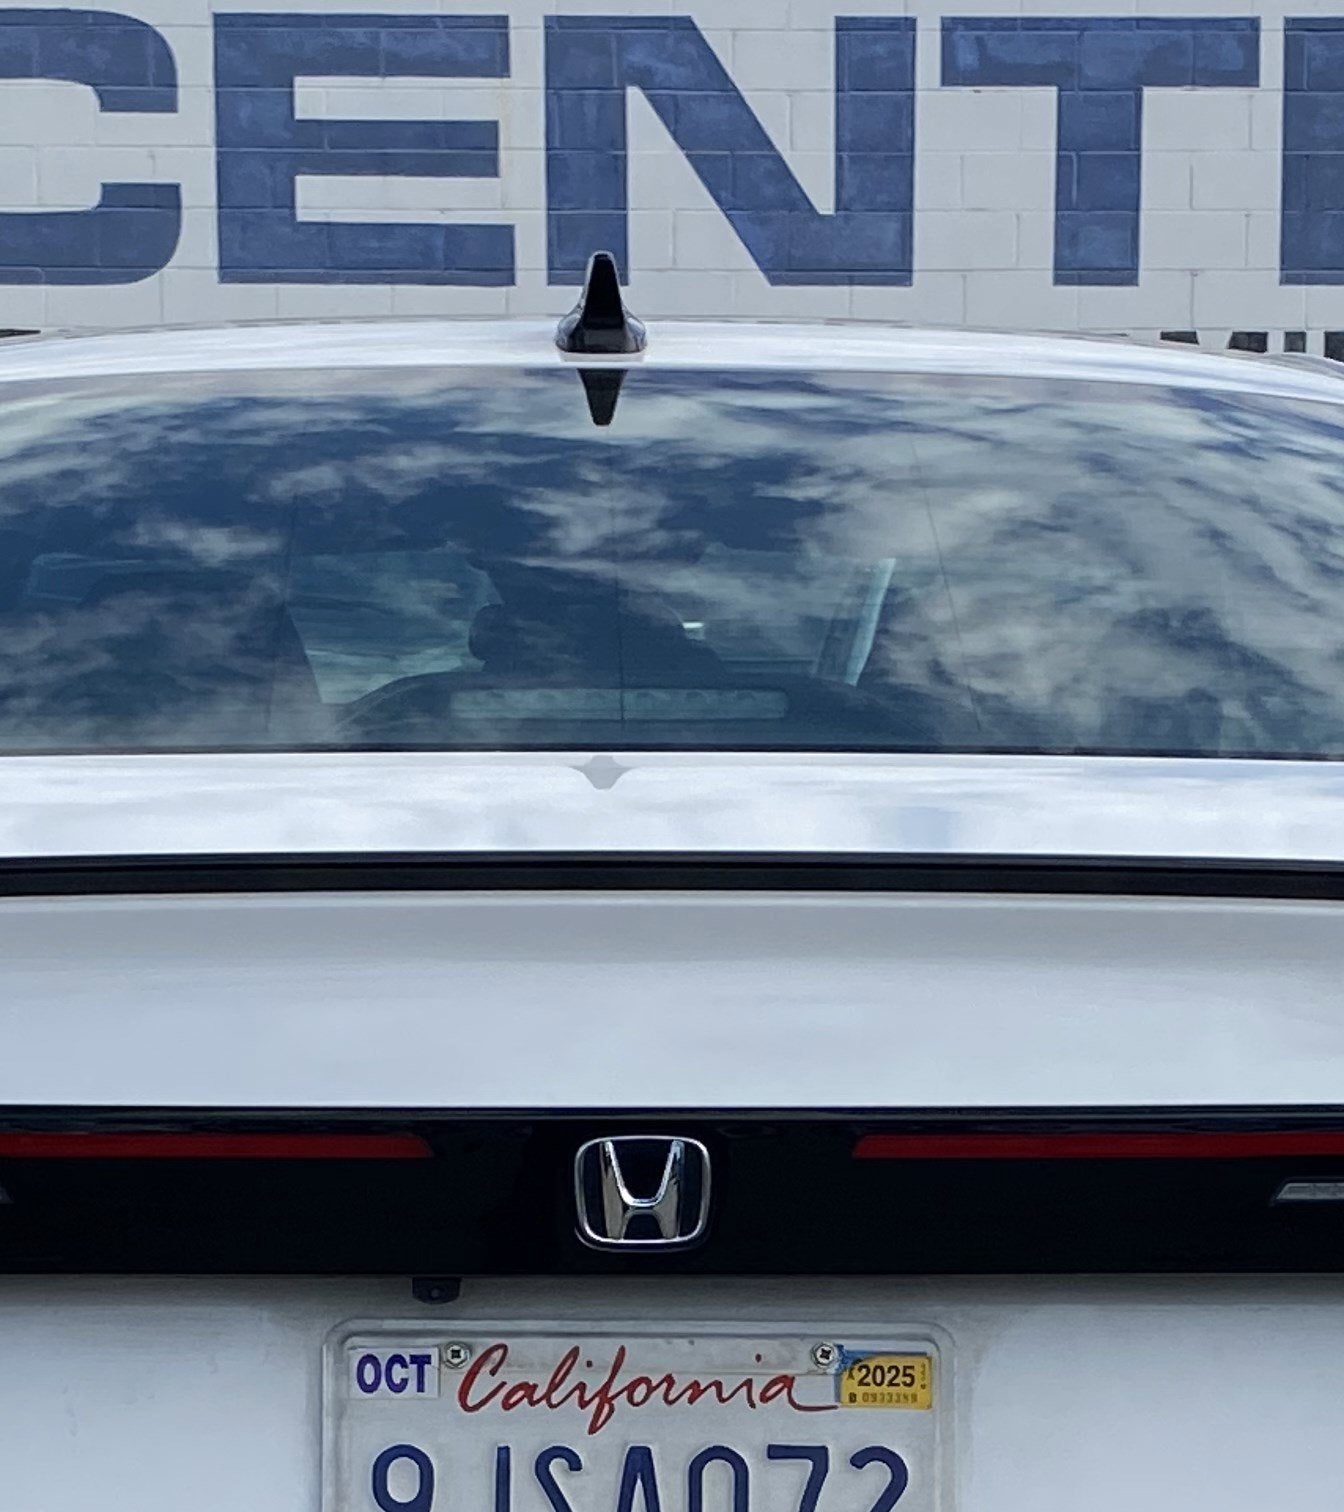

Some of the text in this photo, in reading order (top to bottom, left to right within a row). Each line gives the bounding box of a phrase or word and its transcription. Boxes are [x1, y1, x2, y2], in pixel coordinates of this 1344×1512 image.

[355, 1353, 433, 1394] OCT
[457, 1342, 839, 1436] California
[856, 1364, 916, 1388] 2025
